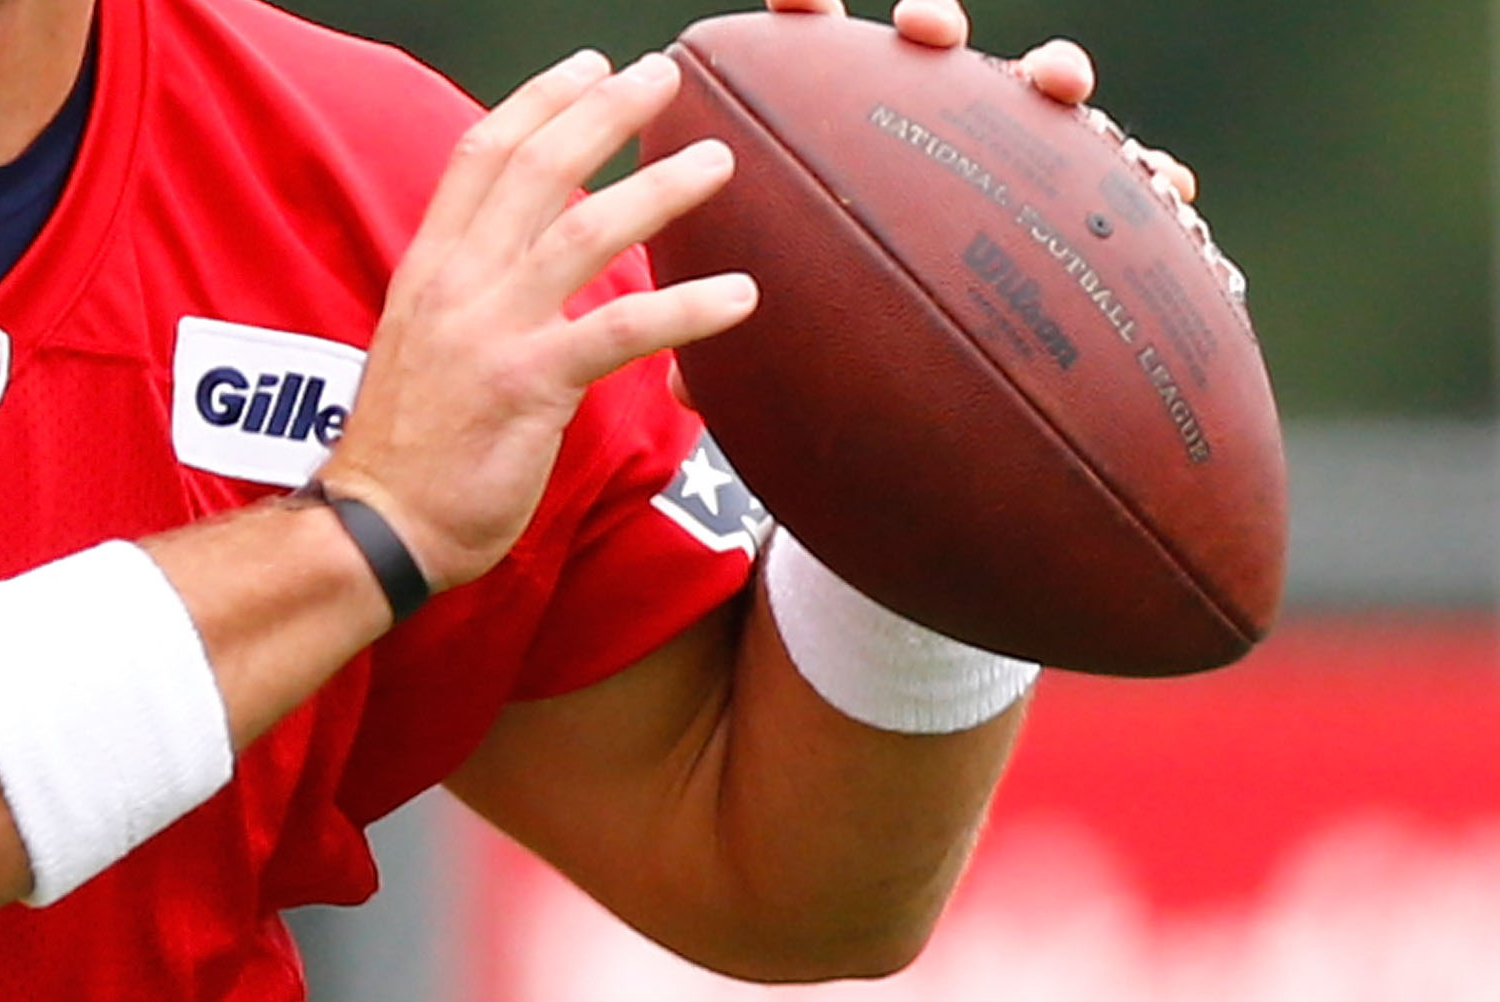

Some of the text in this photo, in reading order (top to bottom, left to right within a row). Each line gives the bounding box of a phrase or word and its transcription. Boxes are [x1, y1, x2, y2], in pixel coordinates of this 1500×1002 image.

[868, 103, 1016, 208] NATIONAL
[1015, 204, 1137, 344] FOOTBALL
[1137, 345, 1210, 463] LEAGUE
[195, 366, 348, 446] Gille
